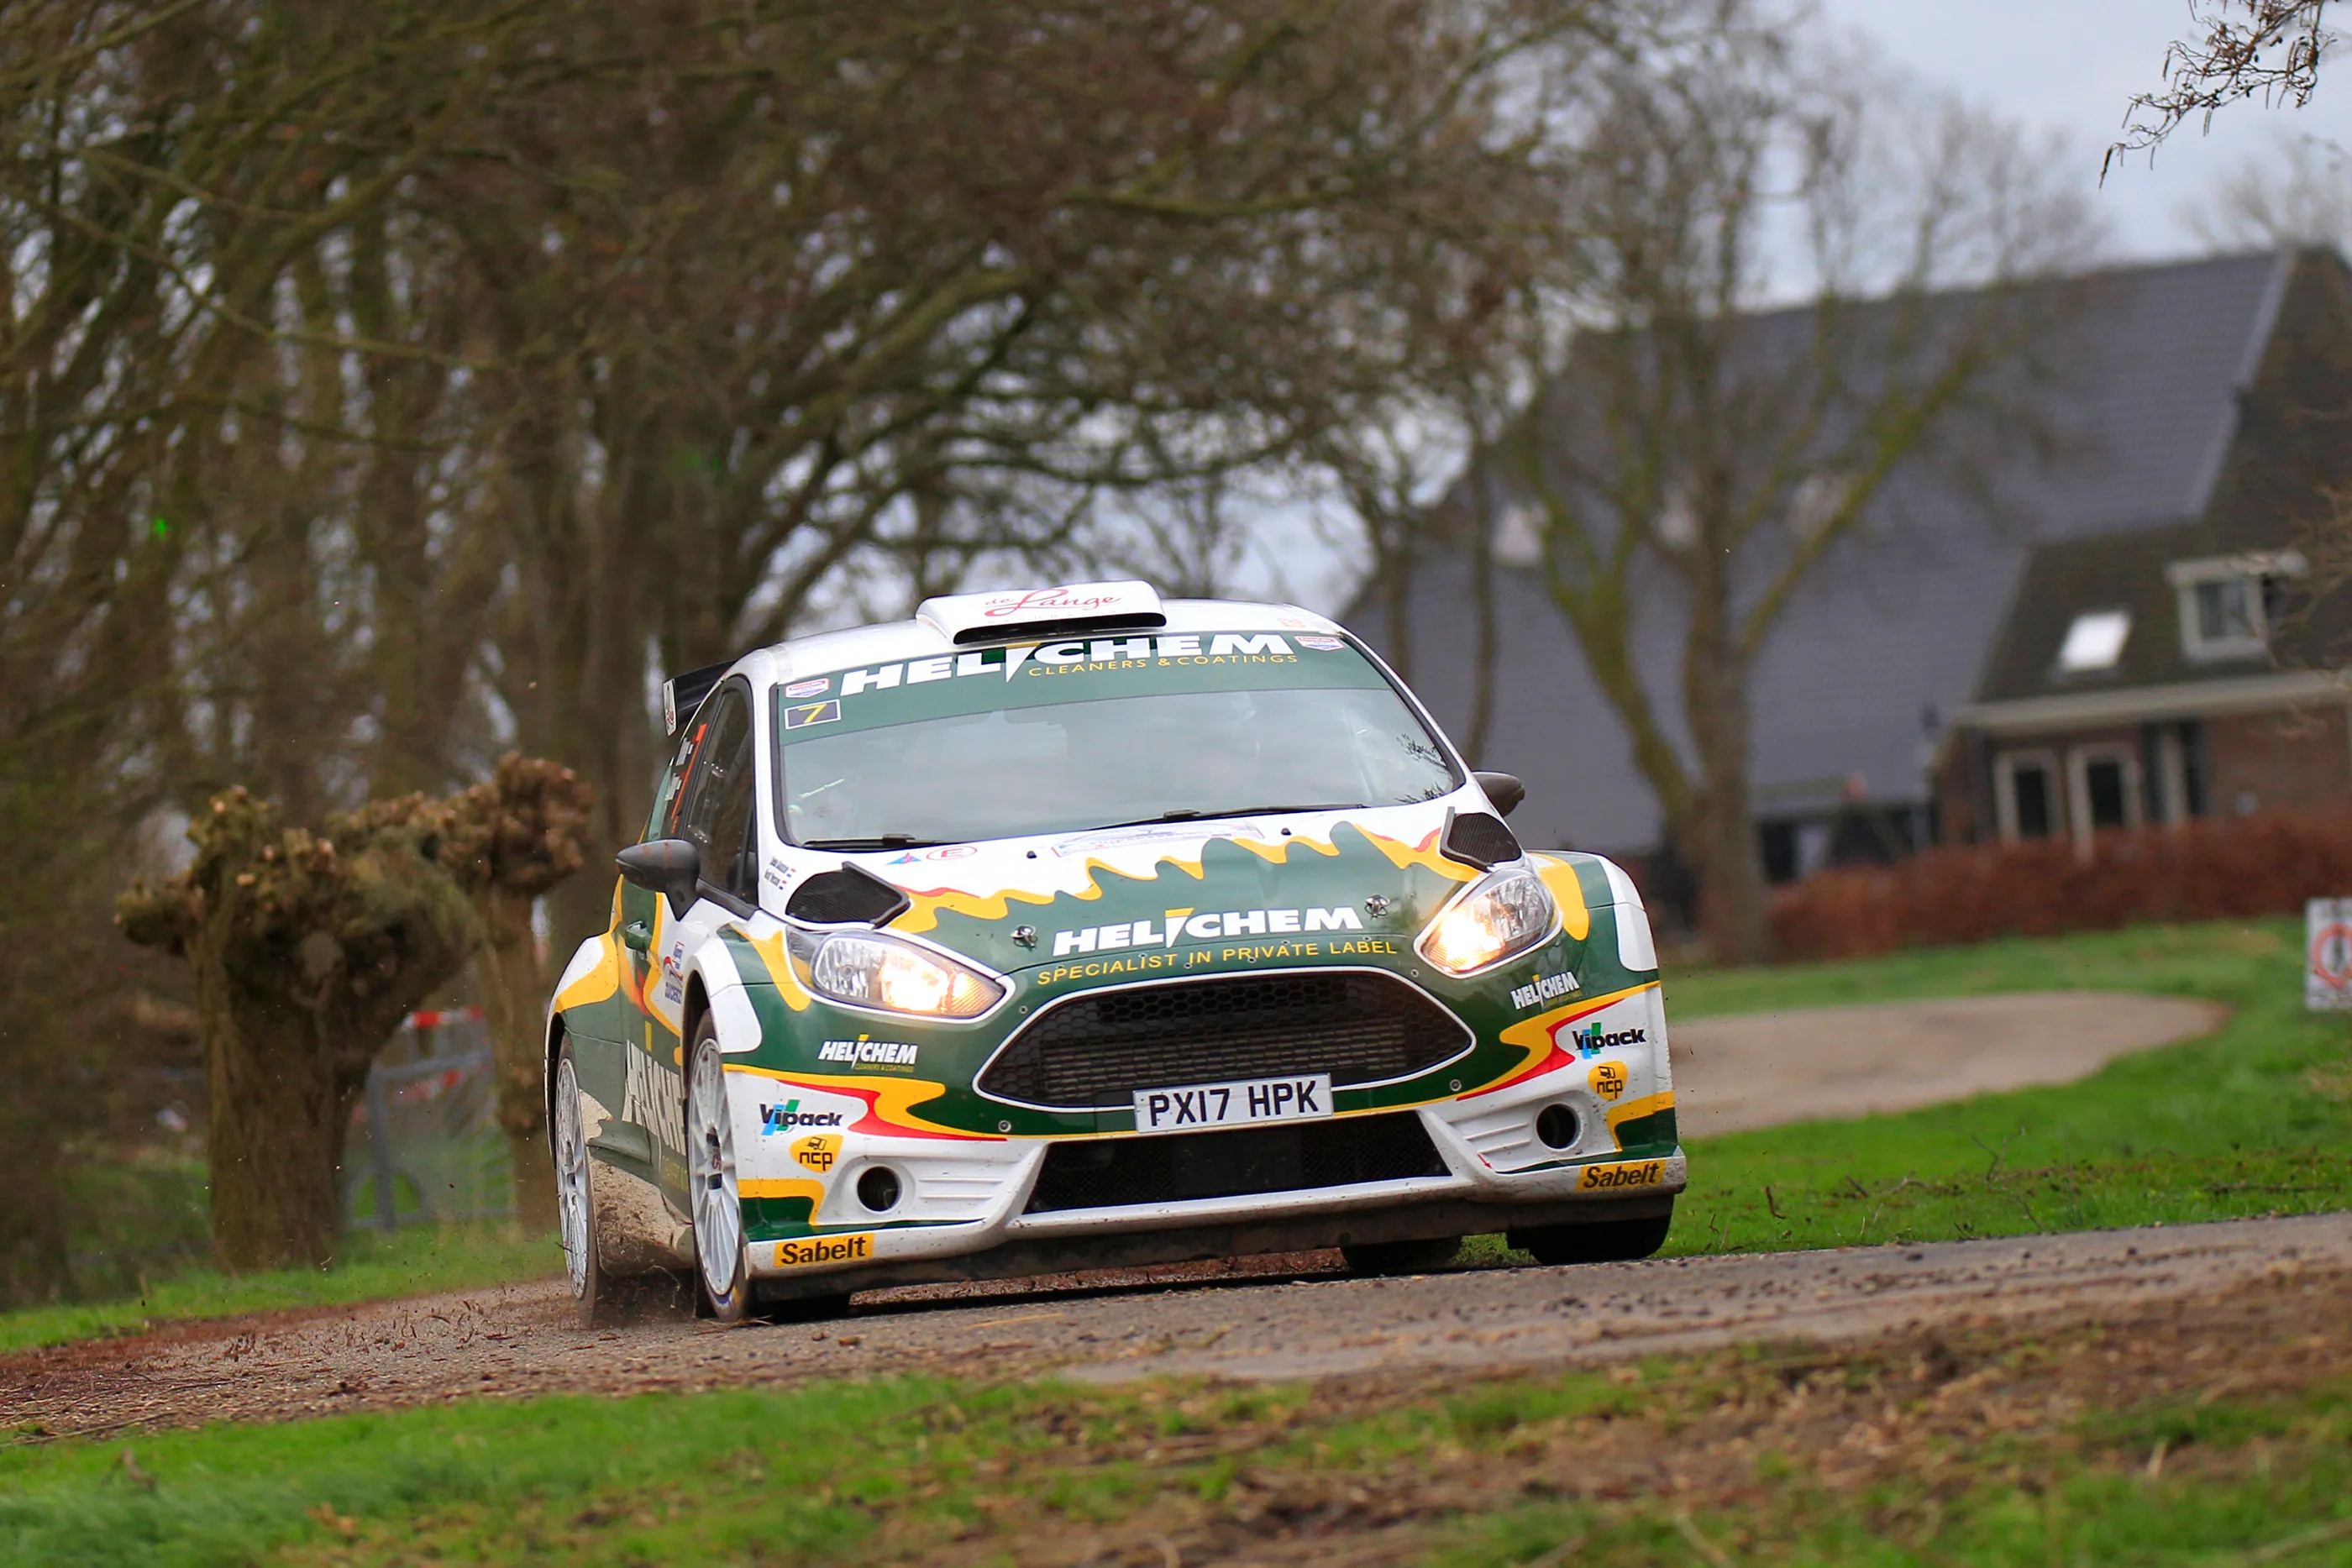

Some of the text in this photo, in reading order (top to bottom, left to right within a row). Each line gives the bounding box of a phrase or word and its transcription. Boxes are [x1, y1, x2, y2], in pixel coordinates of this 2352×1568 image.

[984, 588, 1121, 617] Lange
[840, 634, 1294, 696] HELICHEM
[1028, 659, 1147, 677] CLEANERS
[797, 703, 827, 723] 7
[1053, 907, 1363, 956] HELICHEM
[1037, 941, 1398, 985] SPECIALIST IN PRIVATE LABEL
[1510, 971, 1580, 1009] HELICHEM
[818, 1034, 918, 1071] HELICHEM
[1572, 1029, 1646, 1052] Vipack
[1149, 1080, 1319, 1126] PX17 HPK
[1597, 1079, 1623, 1099] ncp
[759, 1103, 843, 1130] Vipack
[800, 1152, 832, 1172] ncp
[1583, 1162, 1660, 1188] Sabelt
[781, 1236, 866, 1265] Sabelt
